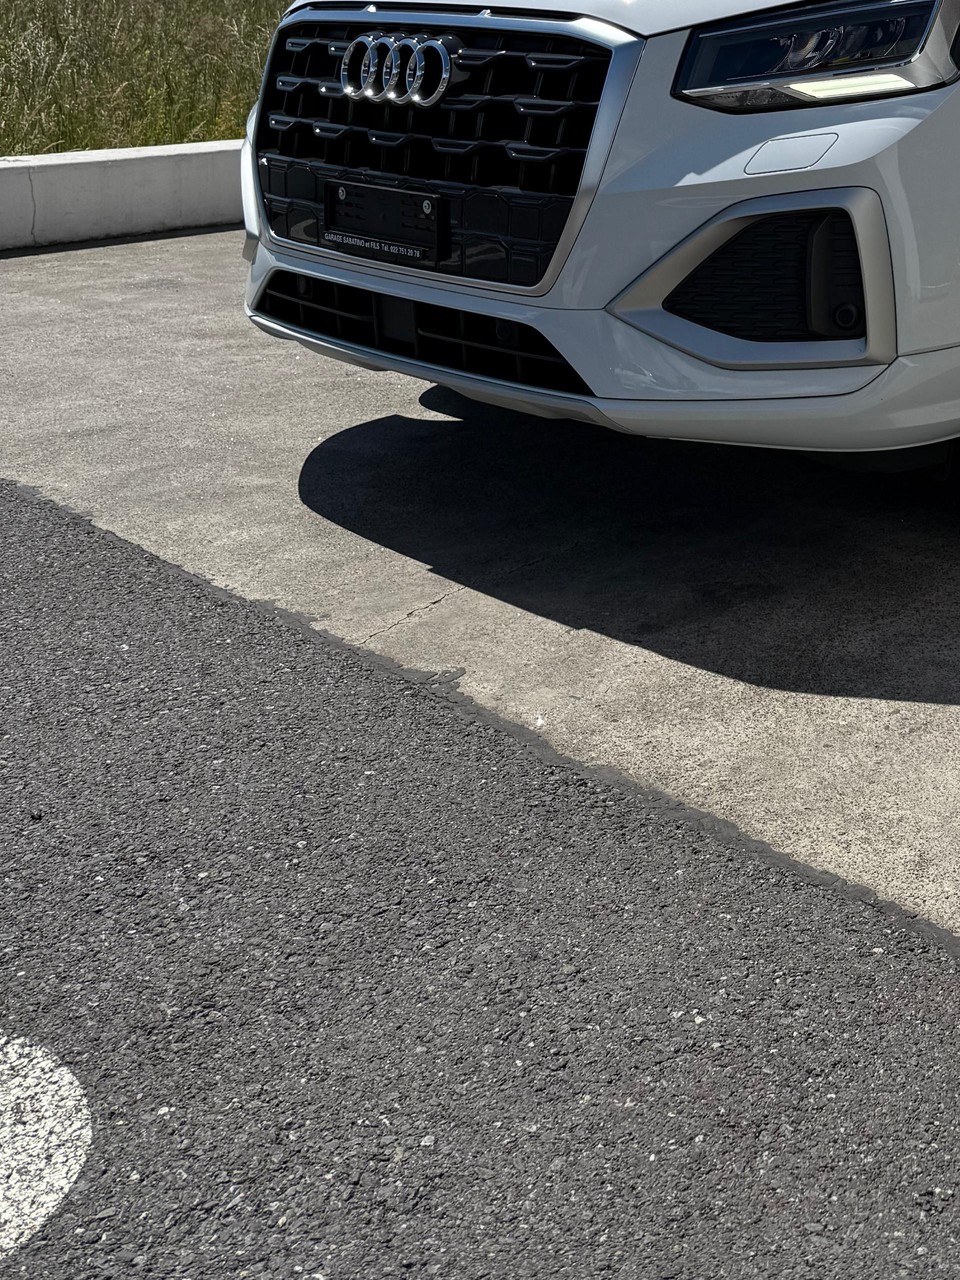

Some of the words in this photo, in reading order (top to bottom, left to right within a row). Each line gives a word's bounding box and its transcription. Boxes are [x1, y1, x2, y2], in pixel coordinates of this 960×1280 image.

[324, 232, 343, 243] GARAGE
[342, 236, 365, 247] SABATINO
[370, 241, 380, 250] FILS
